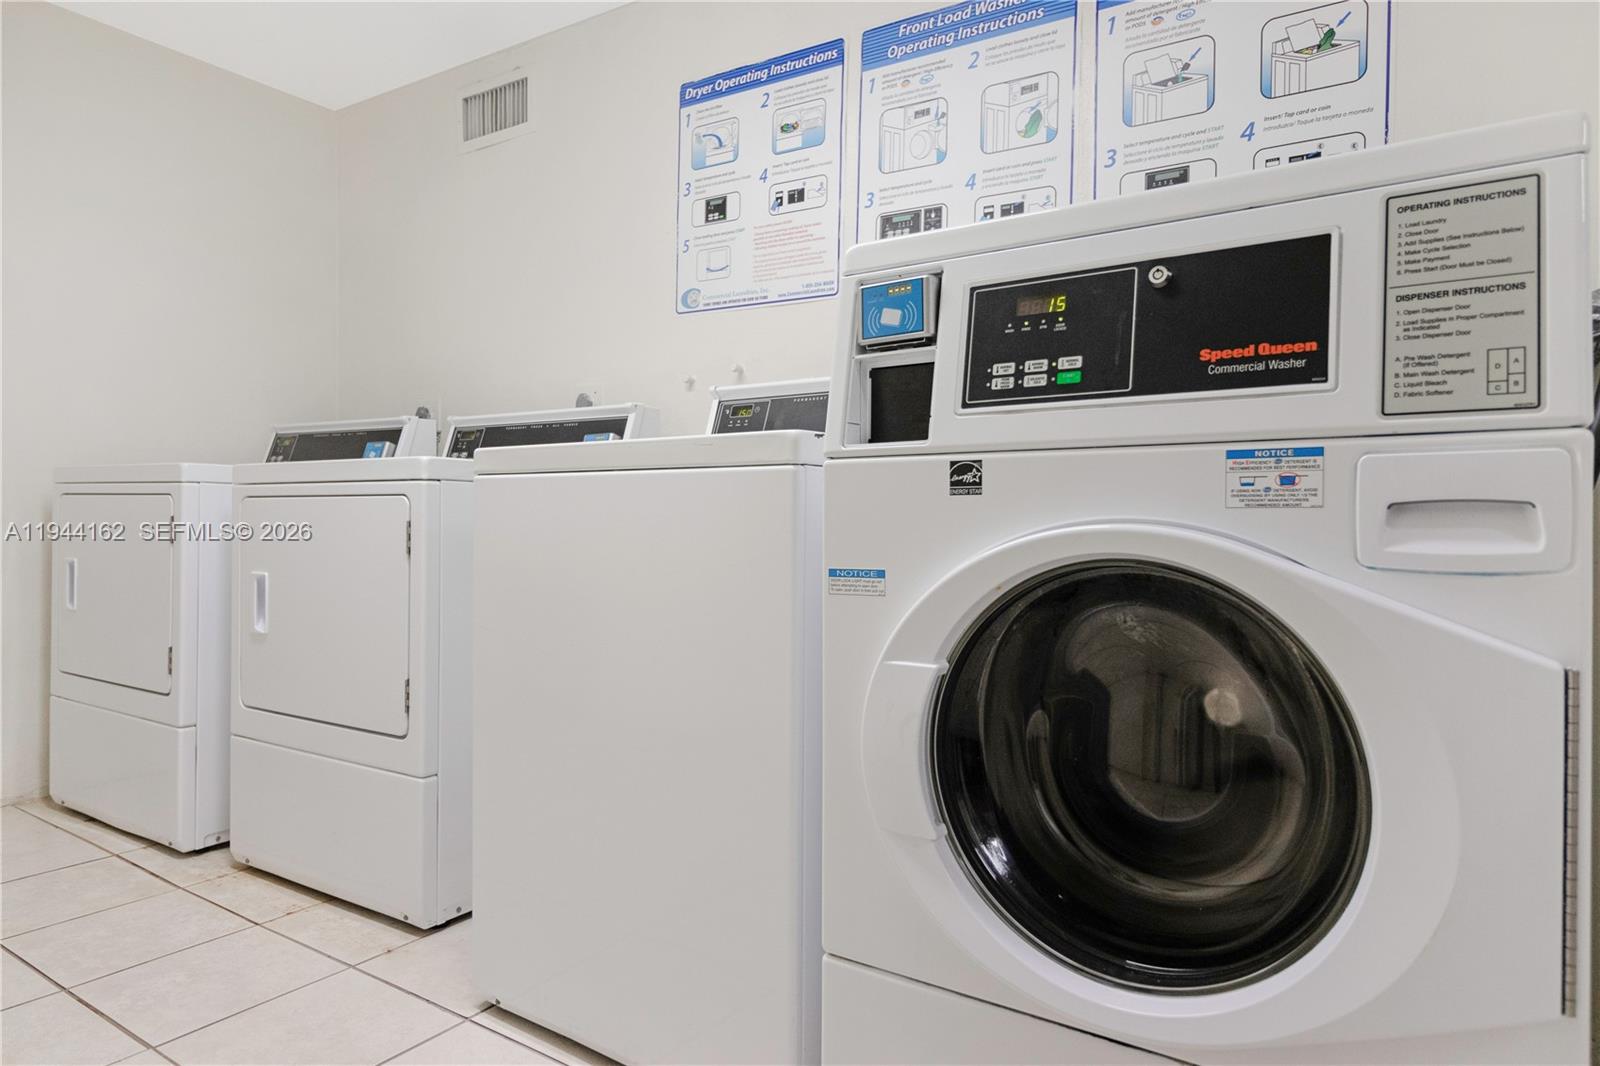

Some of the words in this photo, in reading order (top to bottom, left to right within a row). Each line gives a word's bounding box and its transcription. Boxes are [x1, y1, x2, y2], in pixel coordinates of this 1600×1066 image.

[899, 20, 933, 37] Front
[937, 5, 972, 26] Load
[975, 0, 1025, 15] Washe
[1107, 16, 1117, 35] 1
[887, 31, 955, 58] Operating
[958, 7, 1045, 39] Instructions
[967, 51, 980, 69] 2
[685, 84, 714, 100] Dryer
[714, 68, 768, 91] Operating
[770, 49, 839, 76] Instructions
[868, 78, 876, 94] 1
[760, 92, 770, 108] 2
[685, 113, 691, 128] 1
[1240, 121, 1256, 142] 4
[1104, 149, 1117, 168] 3
[759, 168, 768, 183] 4
[965, 173, 976, 190] 4
[683, 182, 691, 197] 3
[864, 192, 874, 208] 3
[1397, 199, 1450, 214] OPERATING
[1453, 187, 1527, 206] INSTRUCTIONS
[1405, 221, 1420, 229] Load
[1422, 217, 1447, 226] Laundry
[1418, 236, 1445, 245] Supplies
[1446, 234, 1461, 242] (See
[1462, 229, 1499, 239] Instructions
[1501, 225, 1525, 235] Below)
[682, 239, 690, 254] 5
[1423, 247, 1440, 255] Cycle
[1442, 242, 1471, 251] Selection
[1423, 254, 1450, 263] Payment
[1423, 265, 1438, 273] Start
[1440, 263, 1457, 271] (Door
[1486, 256, 1513, 265] Closed)
[1395, 287, 1449, 303] DISPENSER
[1452, 281, 1527, 297] INSTRUCTIONS
[1048, 296, 1067, 313] 15
[1422, 305, 1453, 314] Dispenser
[1420, 317, 1447, 325] Supplies
[1479, 310, 1525, 320] Compartment
[1412, 323, 1440, 332] Indicated
[1422, 331, 1454, 340] Dispenser
[1200, 344, 1255, 363] Speed
[1258, 341, 1318, 356] Queen
[1437, 351, 1471, 360] Detergent
[1208, 361, 1266, 376] Commercial
[1268, 357, 1308, 371] Washer
[1494, 362, 1502, 370] D
[1513, 357, 1520, 365] A
[1421, 369, 1439, 377] Wash
[1441, 368, 1475, 376] Detergent
[1403, 381, 1423, 389] Liquid
[1425, 379, 1448, 387] Bleach
[1513, 379, 1520, 387] B
[1426, 388, 1454, 397] Softener
[1254, 448, 1294, 457] NOTICE
